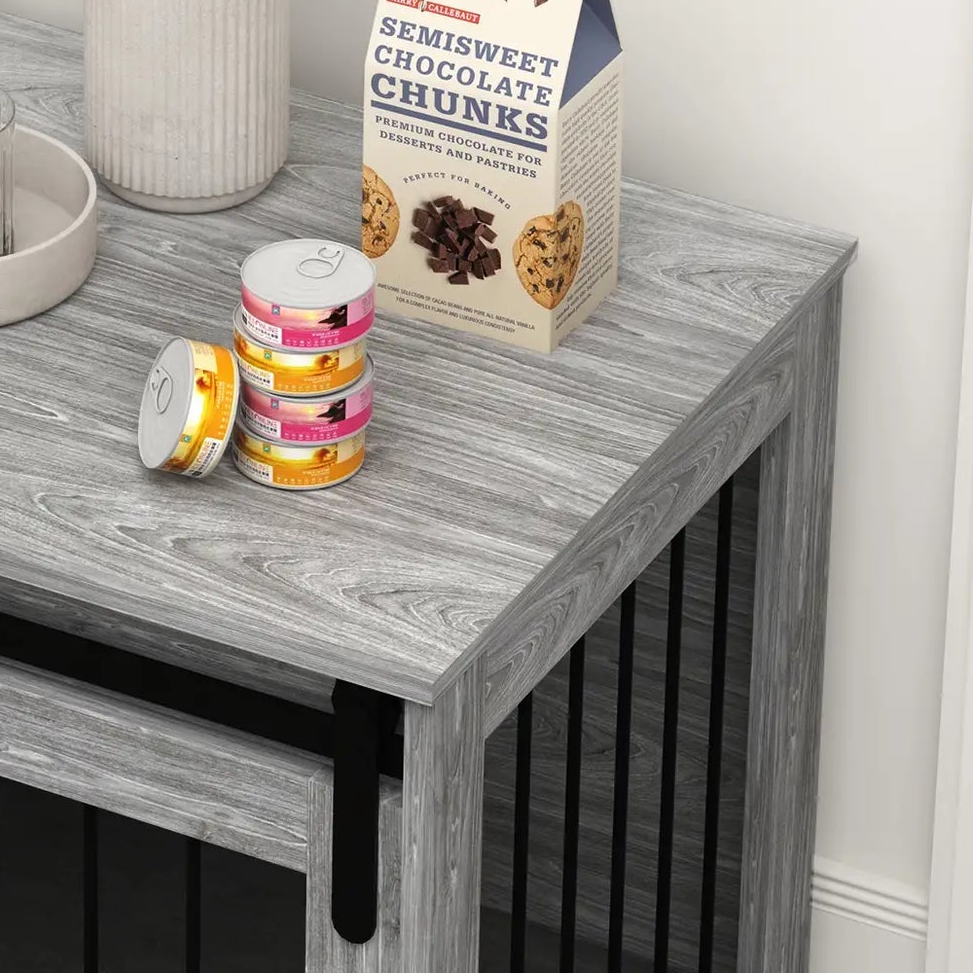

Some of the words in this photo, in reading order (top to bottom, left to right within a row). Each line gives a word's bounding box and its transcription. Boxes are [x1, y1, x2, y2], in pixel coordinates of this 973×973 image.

[427, 3, 479, 23] CALLEBAUT
[379, 16, 559, 78] SEMISWEET
[374, 44, 553, 107] CHOCOLATE
[370, 73, 548, 140] CHUNKS
[375, 115, 435, 138] PREMIUM
[438, 131, 514, 159] CHOCOLATE
[517, 152, 542, 166] FOR
[379, 130, 443, 154] DESSERTS
[446, 148, 473, 162] AND
[476, 155, 537, 179] PASTRIES
[403, 171, 446, 184] PERFECT
[450, 174, 470, 184] FOR
[474, 181, 512, 210] BAKING
[400, 288, 425, 300] SELECTION
